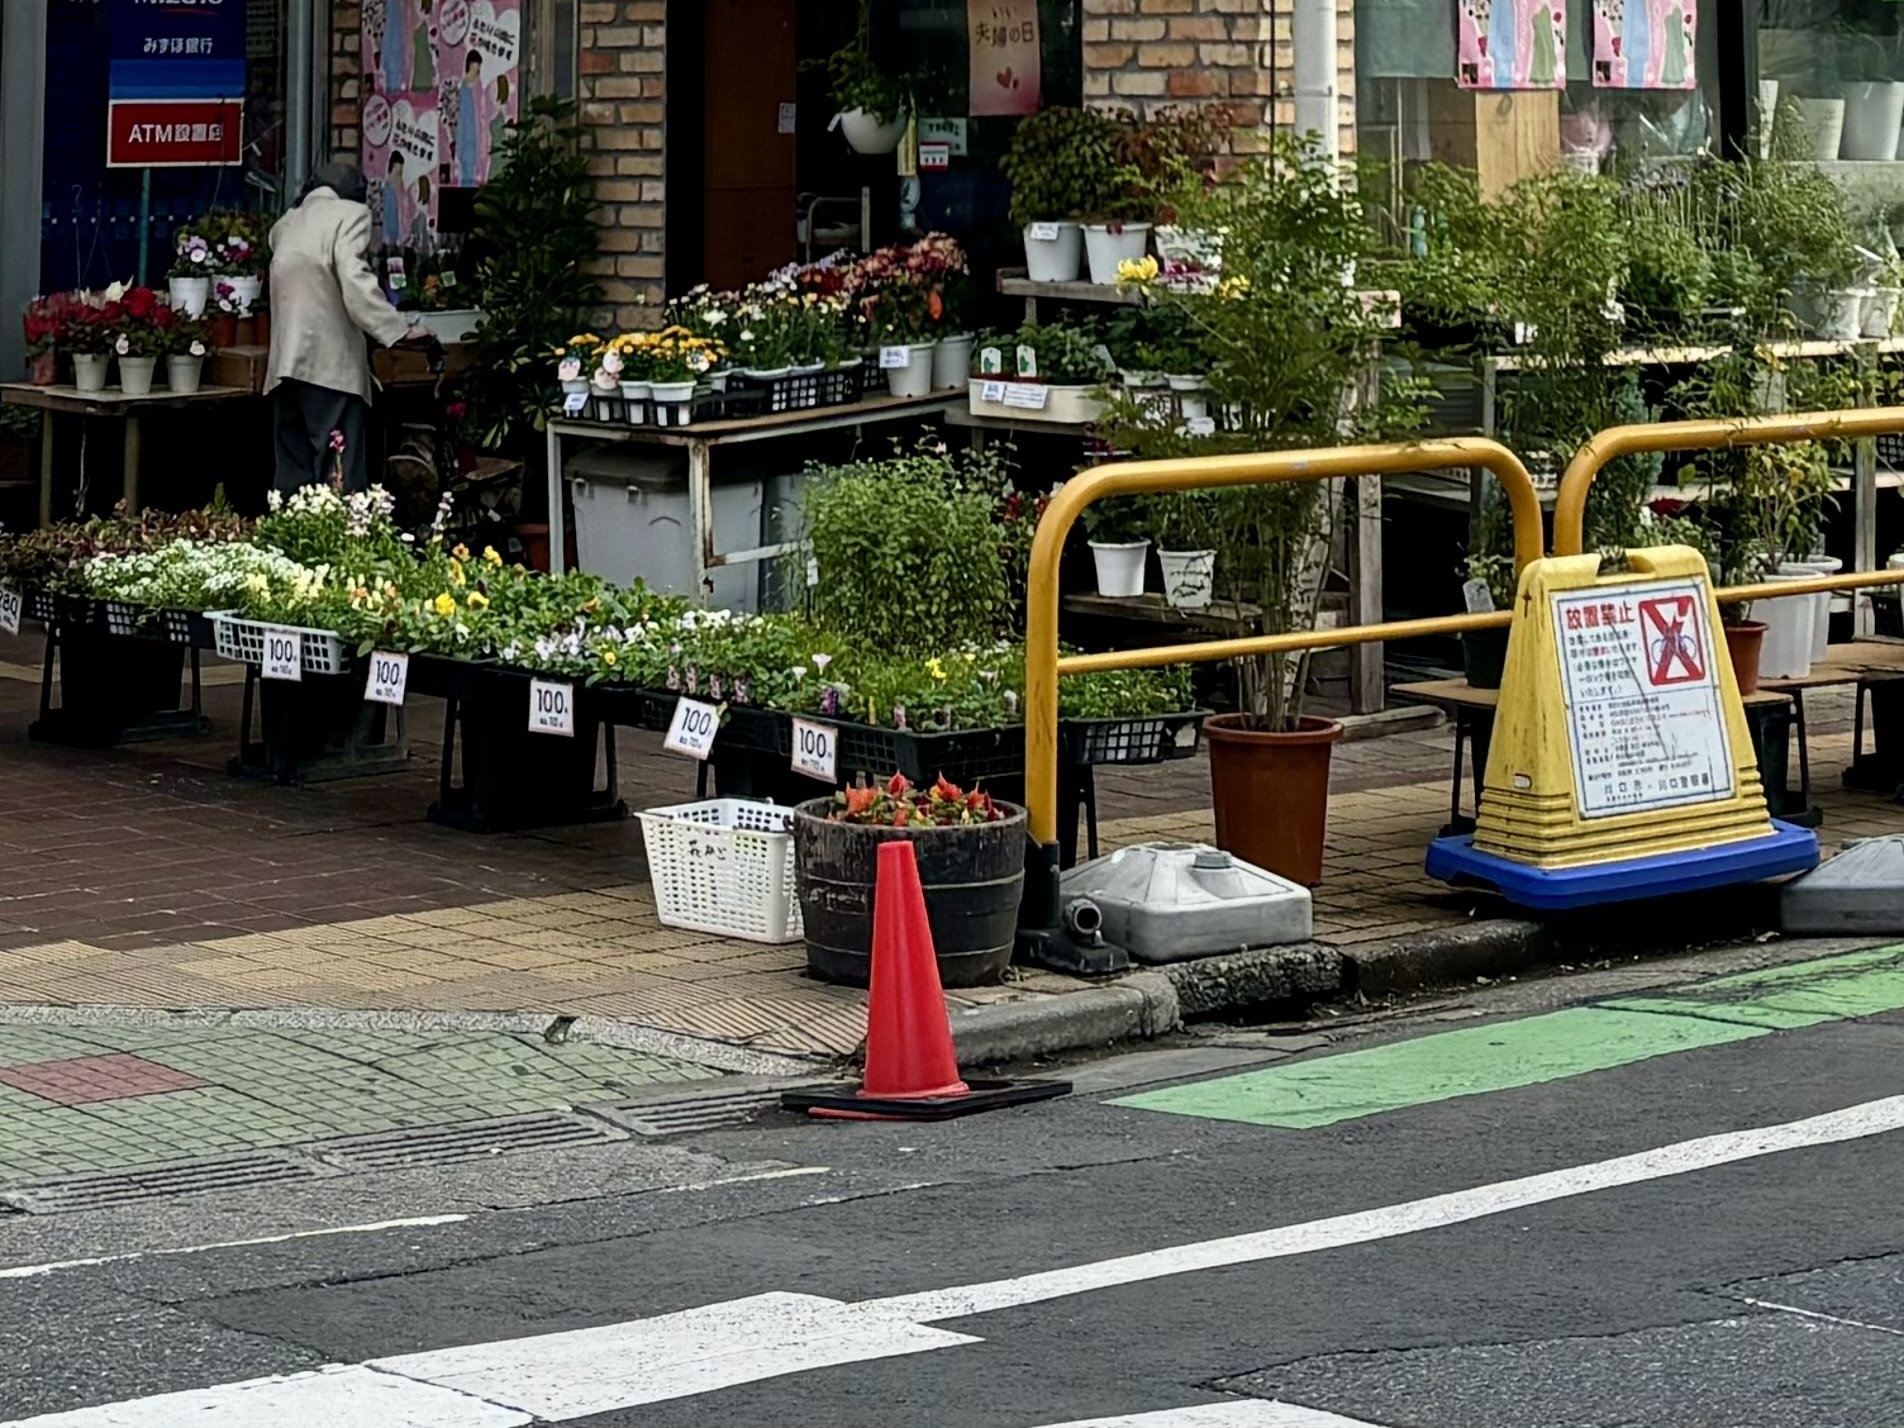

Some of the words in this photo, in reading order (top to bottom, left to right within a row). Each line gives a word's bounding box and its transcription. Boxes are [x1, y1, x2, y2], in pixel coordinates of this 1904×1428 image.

[142, 37, 214, 55] みずほ銀行
[1566, 600, 1636, 631] 放置禁止
